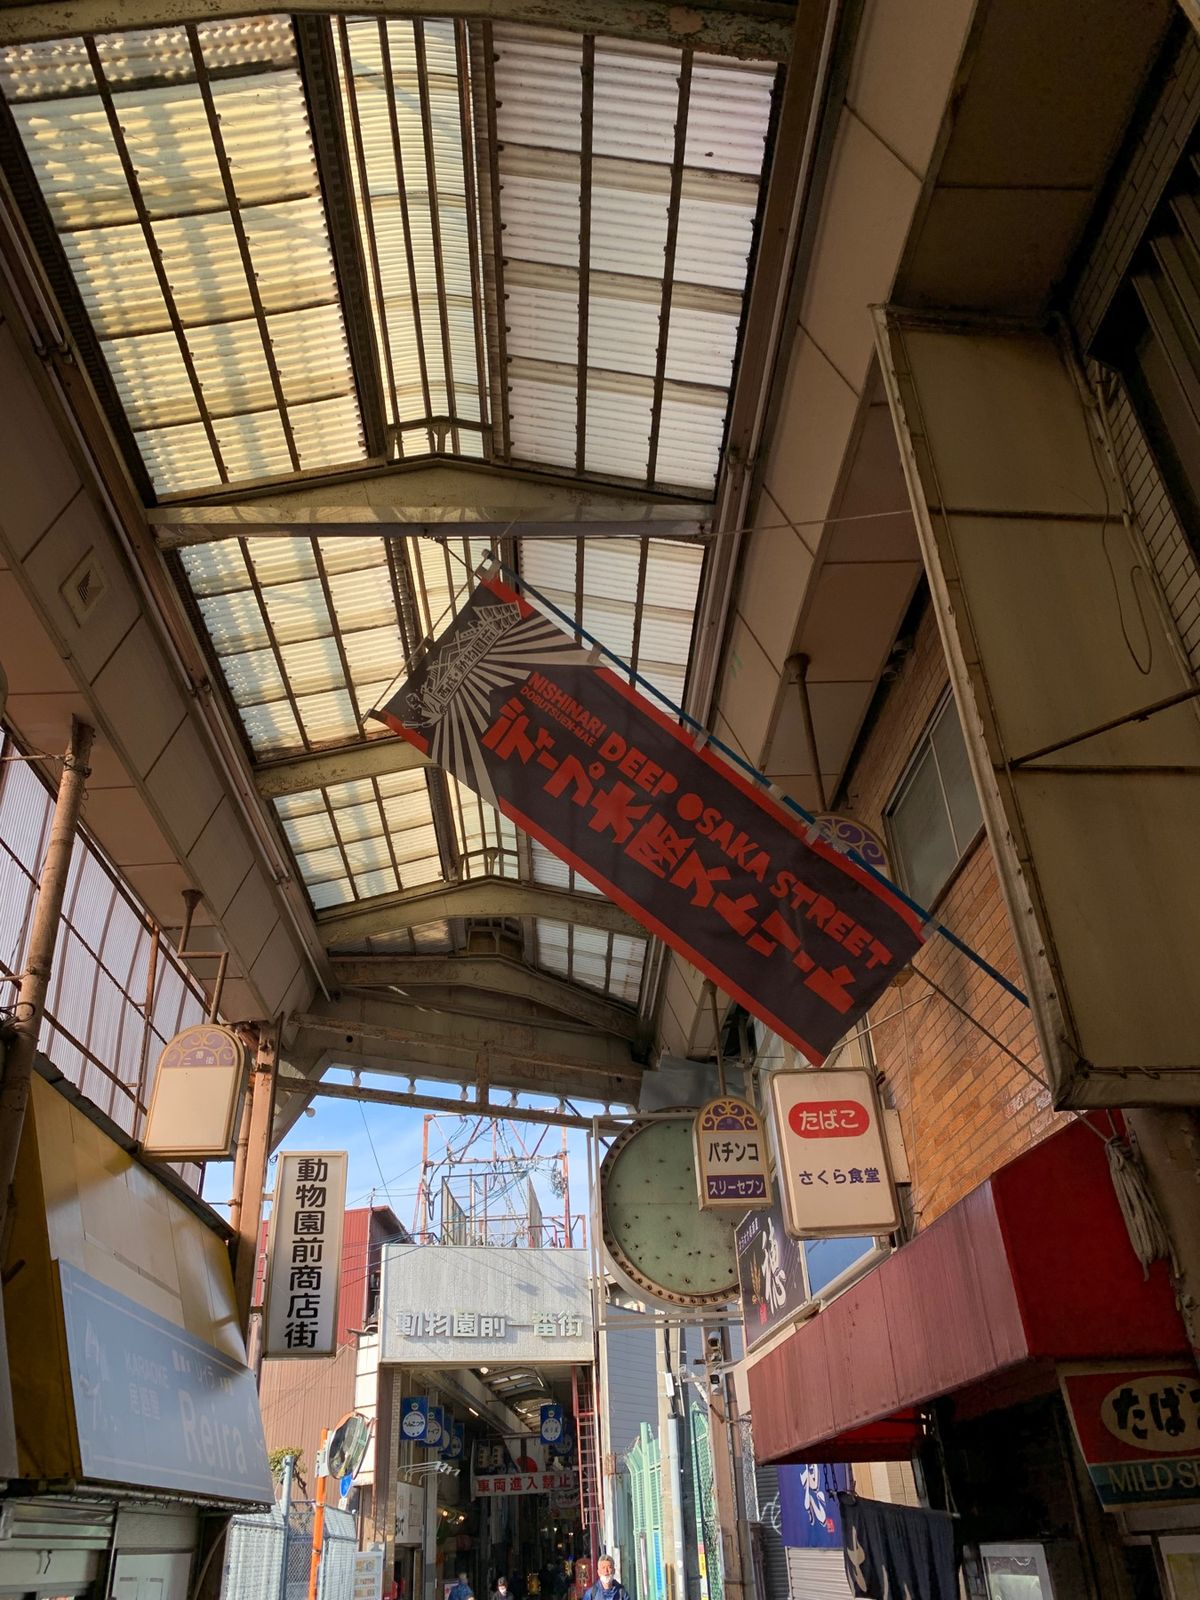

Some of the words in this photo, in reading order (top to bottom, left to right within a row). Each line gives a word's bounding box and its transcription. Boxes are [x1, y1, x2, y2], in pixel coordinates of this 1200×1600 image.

[520, 686, 598, 748] DOBUTSUEN-MAE
[527, 671, 608, 738] NISHINARI
[598, 731, 679, 798] DEEP
[677, 793, 771, 883] OSAKA
[769, 870, 893, 970] STREET
[799, 1108, 859, 1131] たばこ
[708, 1141, 760, 1163] パチンコ
[708, 1177, 765, 1196] スリーセブン
[799, 1166, 881, 1186] さくら食堂
[284, 1157, 329, 1350] 動物園前商店街
[395, 1310, 584, 1337] 動物園前一番街
[178, 1388, 249, 1475] Reira
[476, 1474, 571, 1493] 車両進入禁止
[1107, 1463, 1174, 1494] MILD
